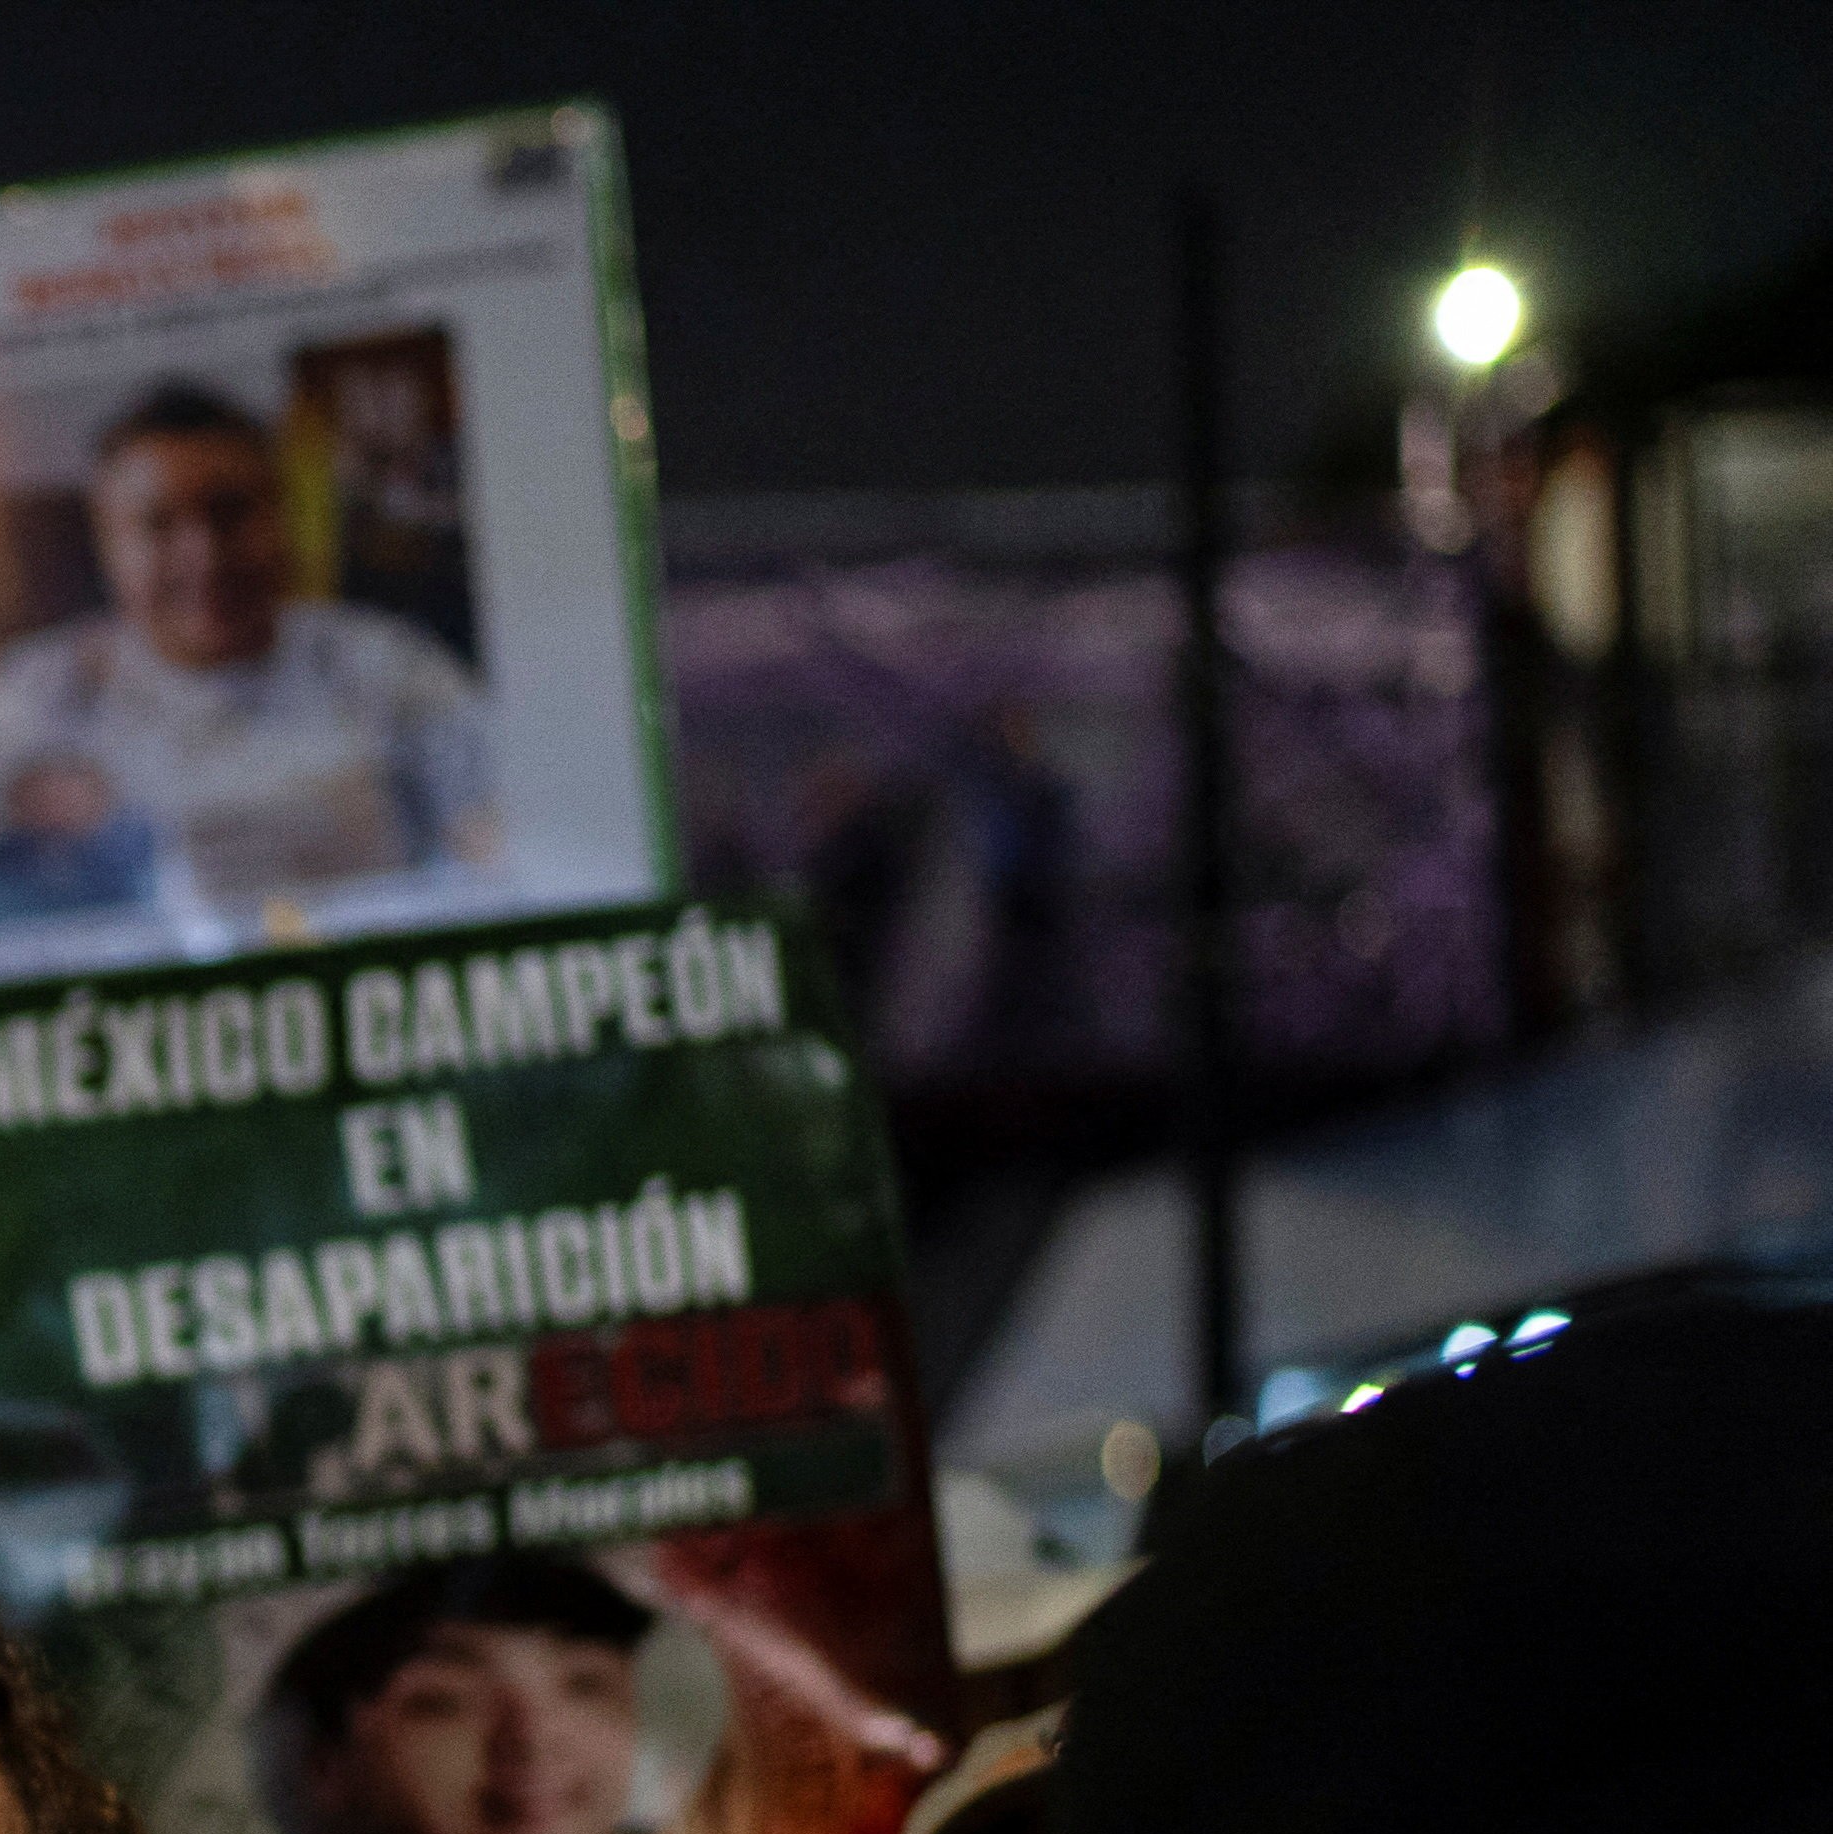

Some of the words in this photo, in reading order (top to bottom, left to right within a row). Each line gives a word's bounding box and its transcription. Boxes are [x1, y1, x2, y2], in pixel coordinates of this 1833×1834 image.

[341, 906, 787, 1087] CAMPEÓN
[338, 1093, 474, 1218] EN
[66, 1174, 752, 1391] DESAPARICIÓN
